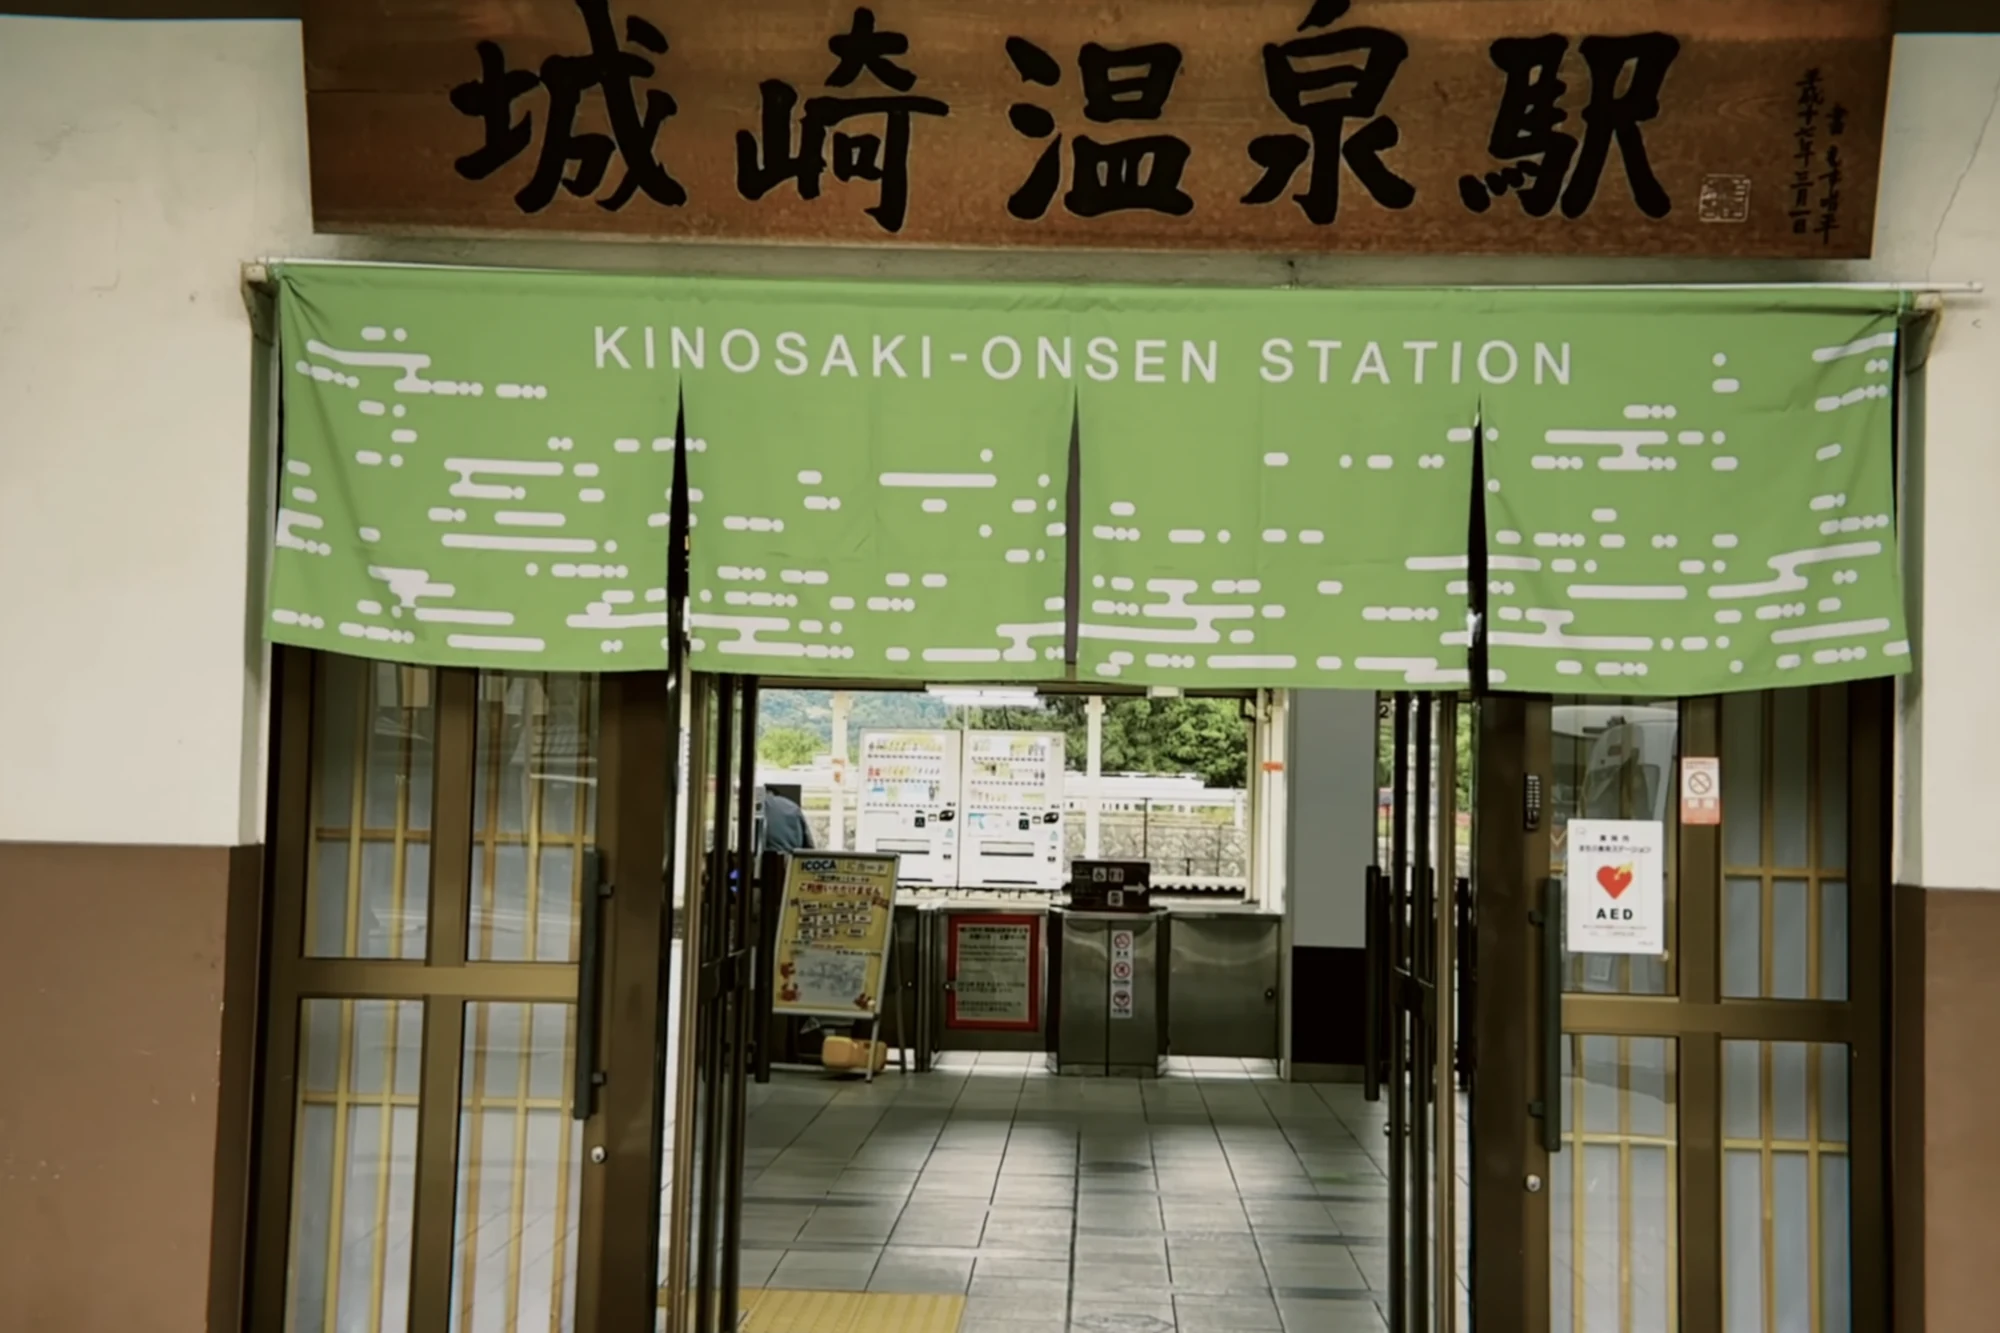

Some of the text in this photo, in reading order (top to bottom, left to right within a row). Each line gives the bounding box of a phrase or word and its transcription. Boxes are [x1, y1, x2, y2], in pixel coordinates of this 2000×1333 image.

[449, 0, 1680, 232] 城崎温泉駅
[594, 325, 1572, 385] KINOSAKI-ONSEN STATION
[801, 859, 837, 871] ICOCA
[1596, 907, 1633, 920] AED
